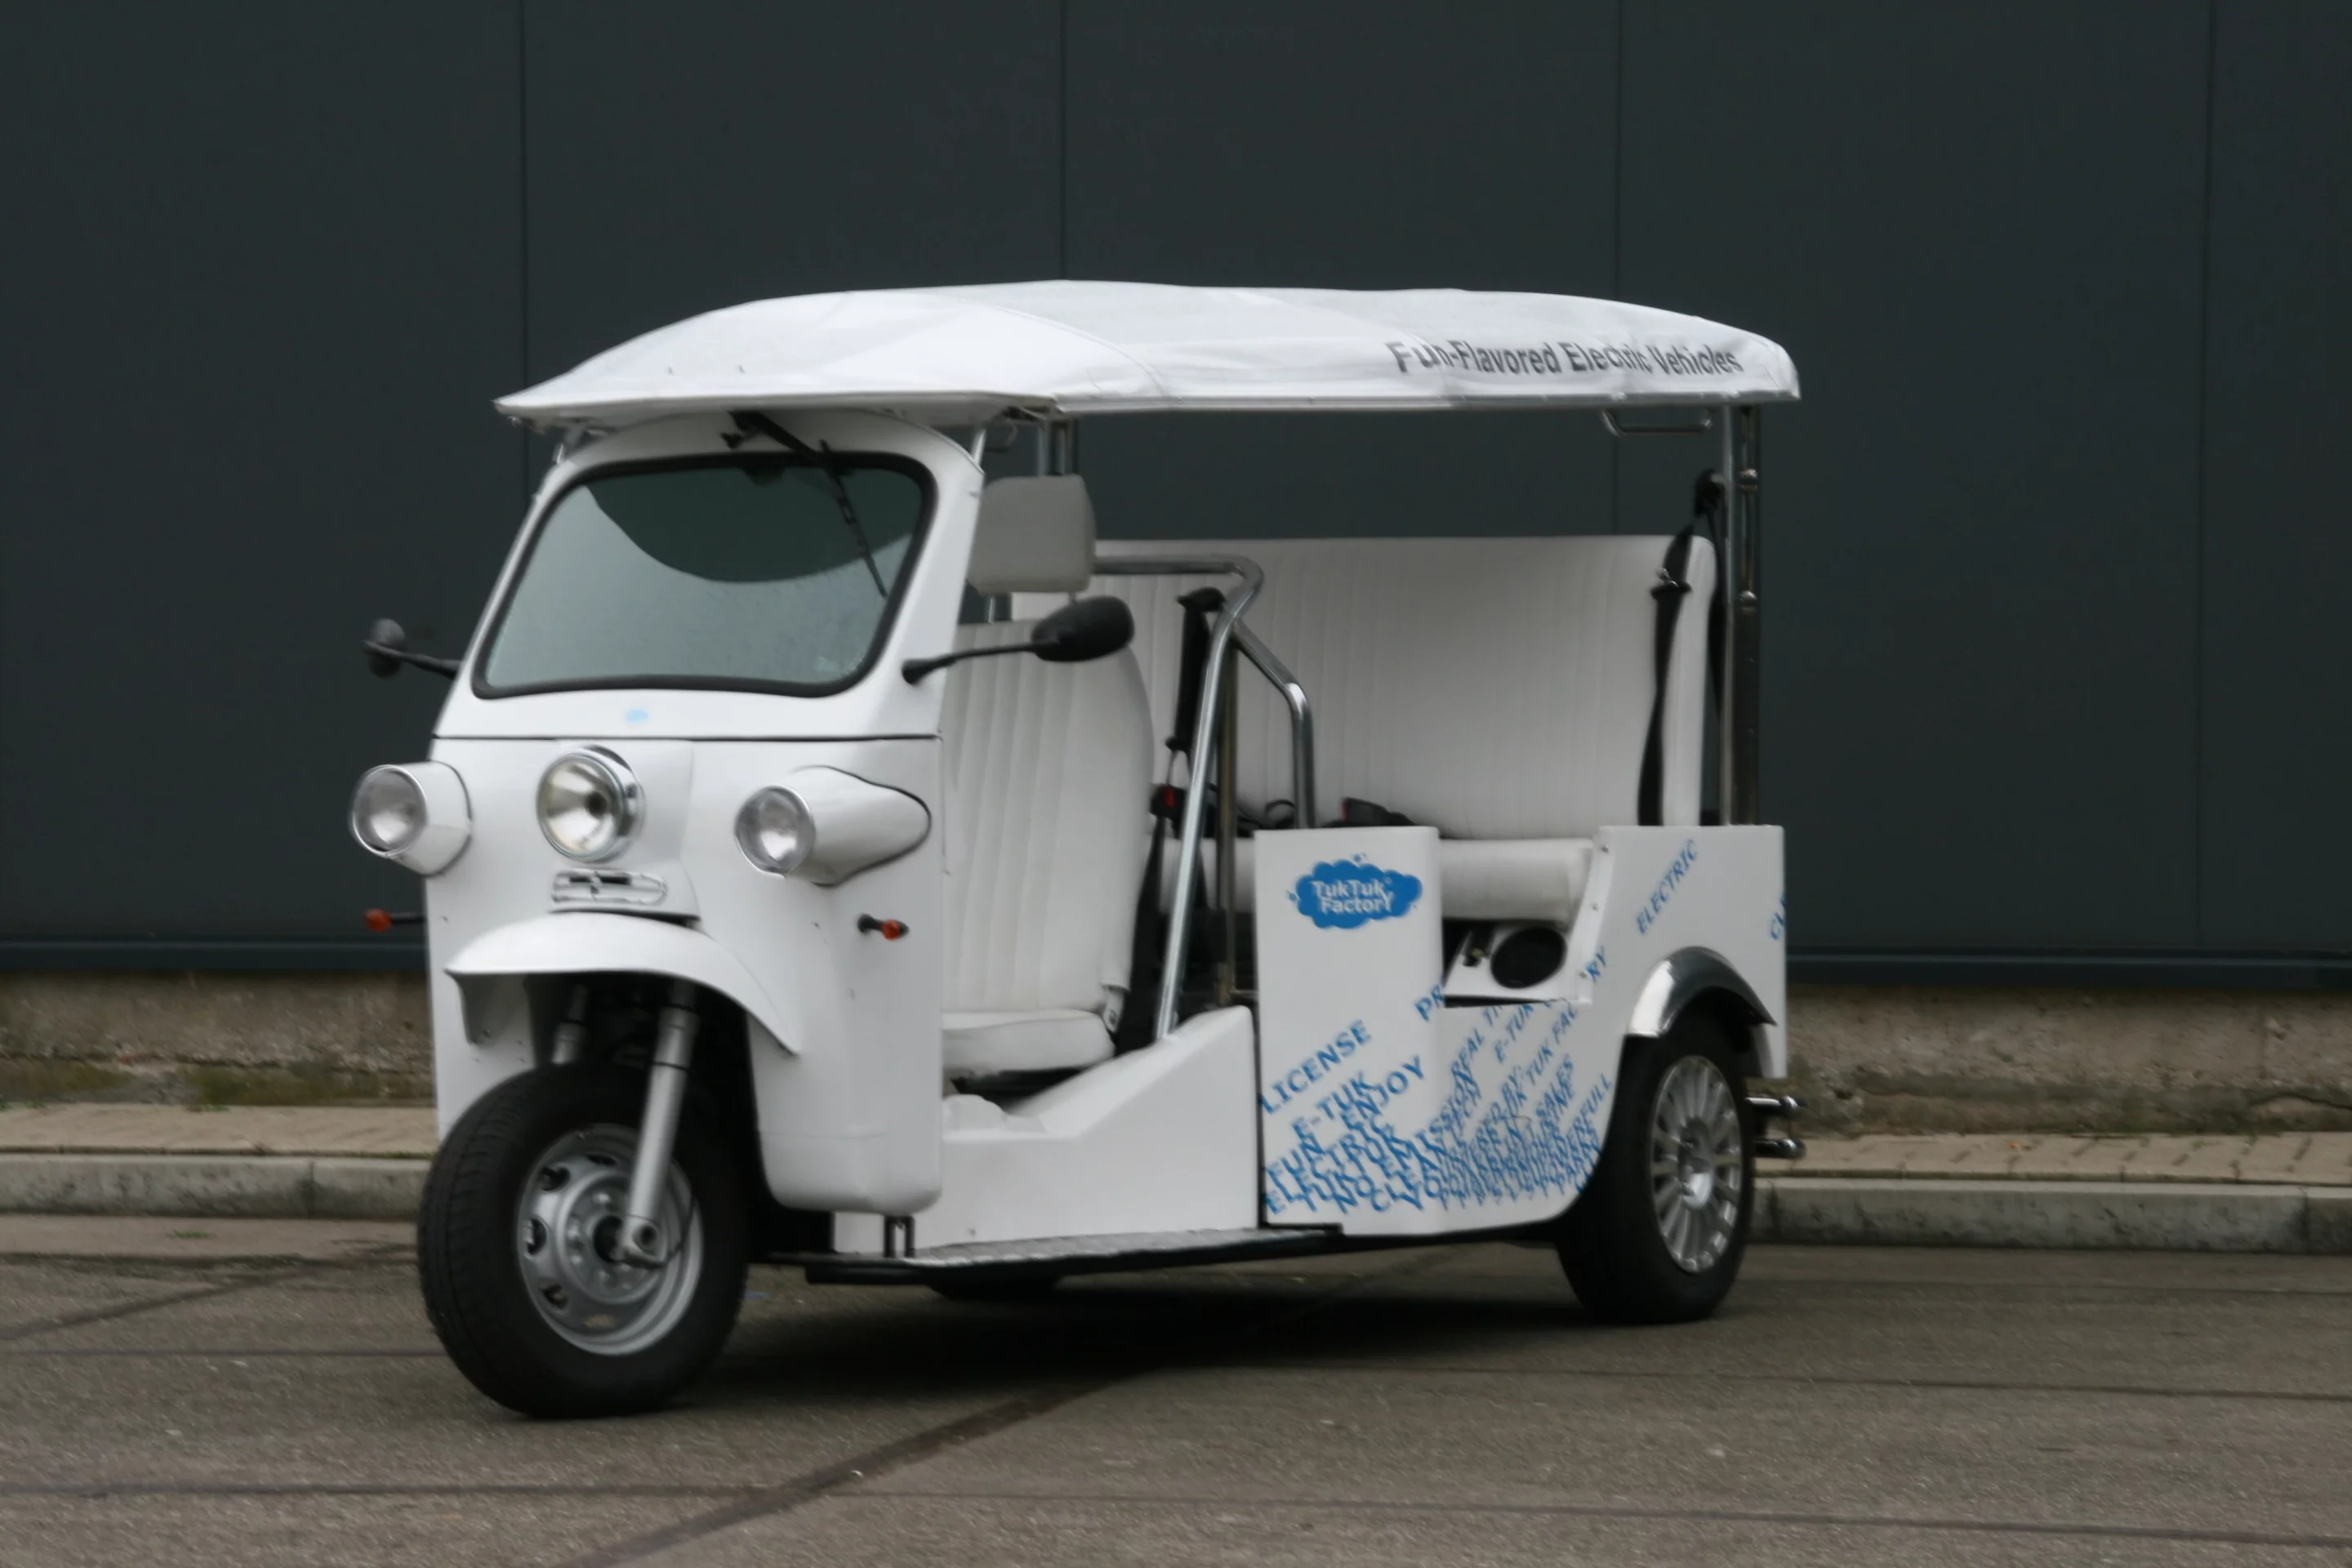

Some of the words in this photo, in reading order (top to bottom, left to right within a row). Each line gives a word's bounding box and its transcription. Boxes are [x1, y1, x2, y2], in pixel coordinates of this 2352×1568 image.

[1558, 341, 1652, 373] Electric
[1646, 344, 1744, 376] Vehicles
[1312, 879, 1387, 898] TukTuk
[1636, 839, 1698, 935] ELECTRIC
[1260, 1018, 1373, 1116] LICENSE
